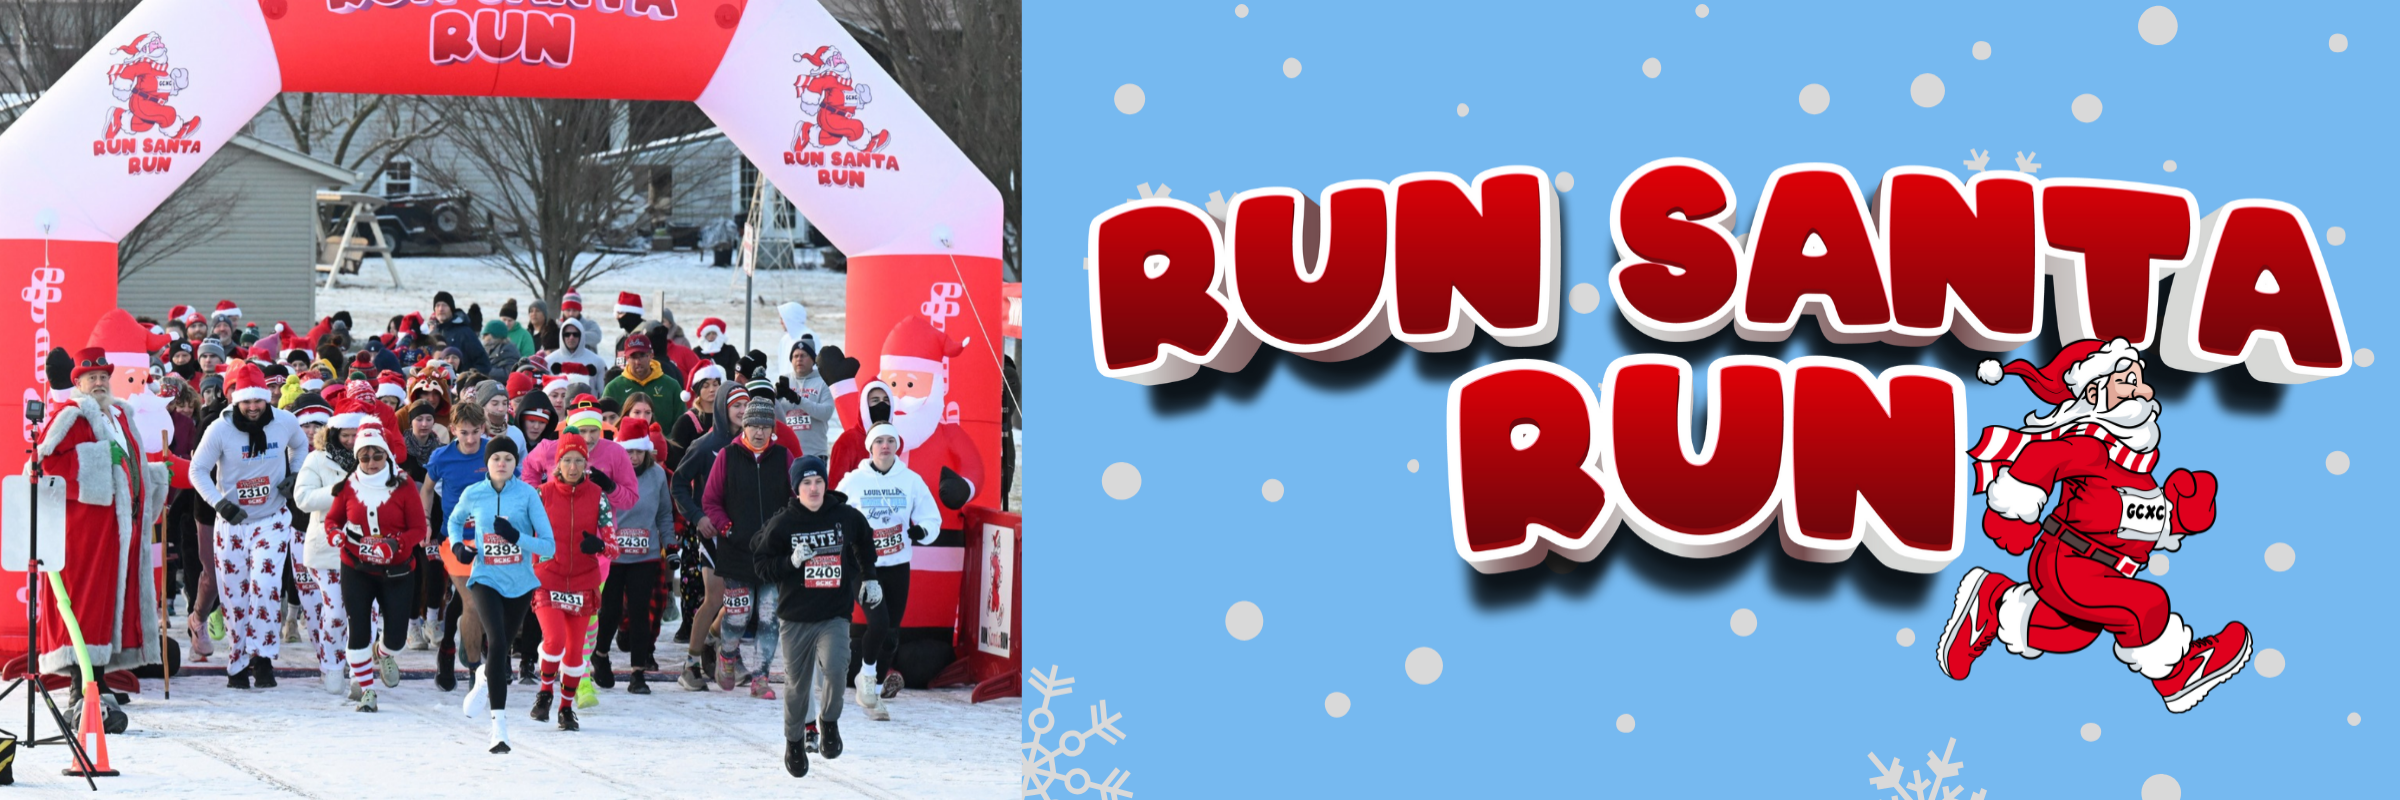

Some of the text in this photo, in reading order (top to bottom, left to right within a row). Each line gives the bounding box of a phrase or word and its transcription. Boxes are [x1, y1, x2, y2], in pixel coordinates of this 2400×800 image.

[430, 9, 575, 68] RUN
[93, 138, 201, 156] RUN SANTA
[128, 156, 172, 175] RUN
[783, 151, 899, 171] RUN SANTA
[818, 169, 865, 188] RUN
[787, 417, 809, 425] 2351
[239, 486, 269, 499] 2310
[617, 537, 648, 547] 2430
[791, 532, 836, 549] STATE
[874, 534, 902, 549] 2353
[485, 544, 520, 556] 2393
[806, 567, 841, 578] 2409
[552, 592, 582, 606] 2431
[723, 596, 749, 607] 2489
